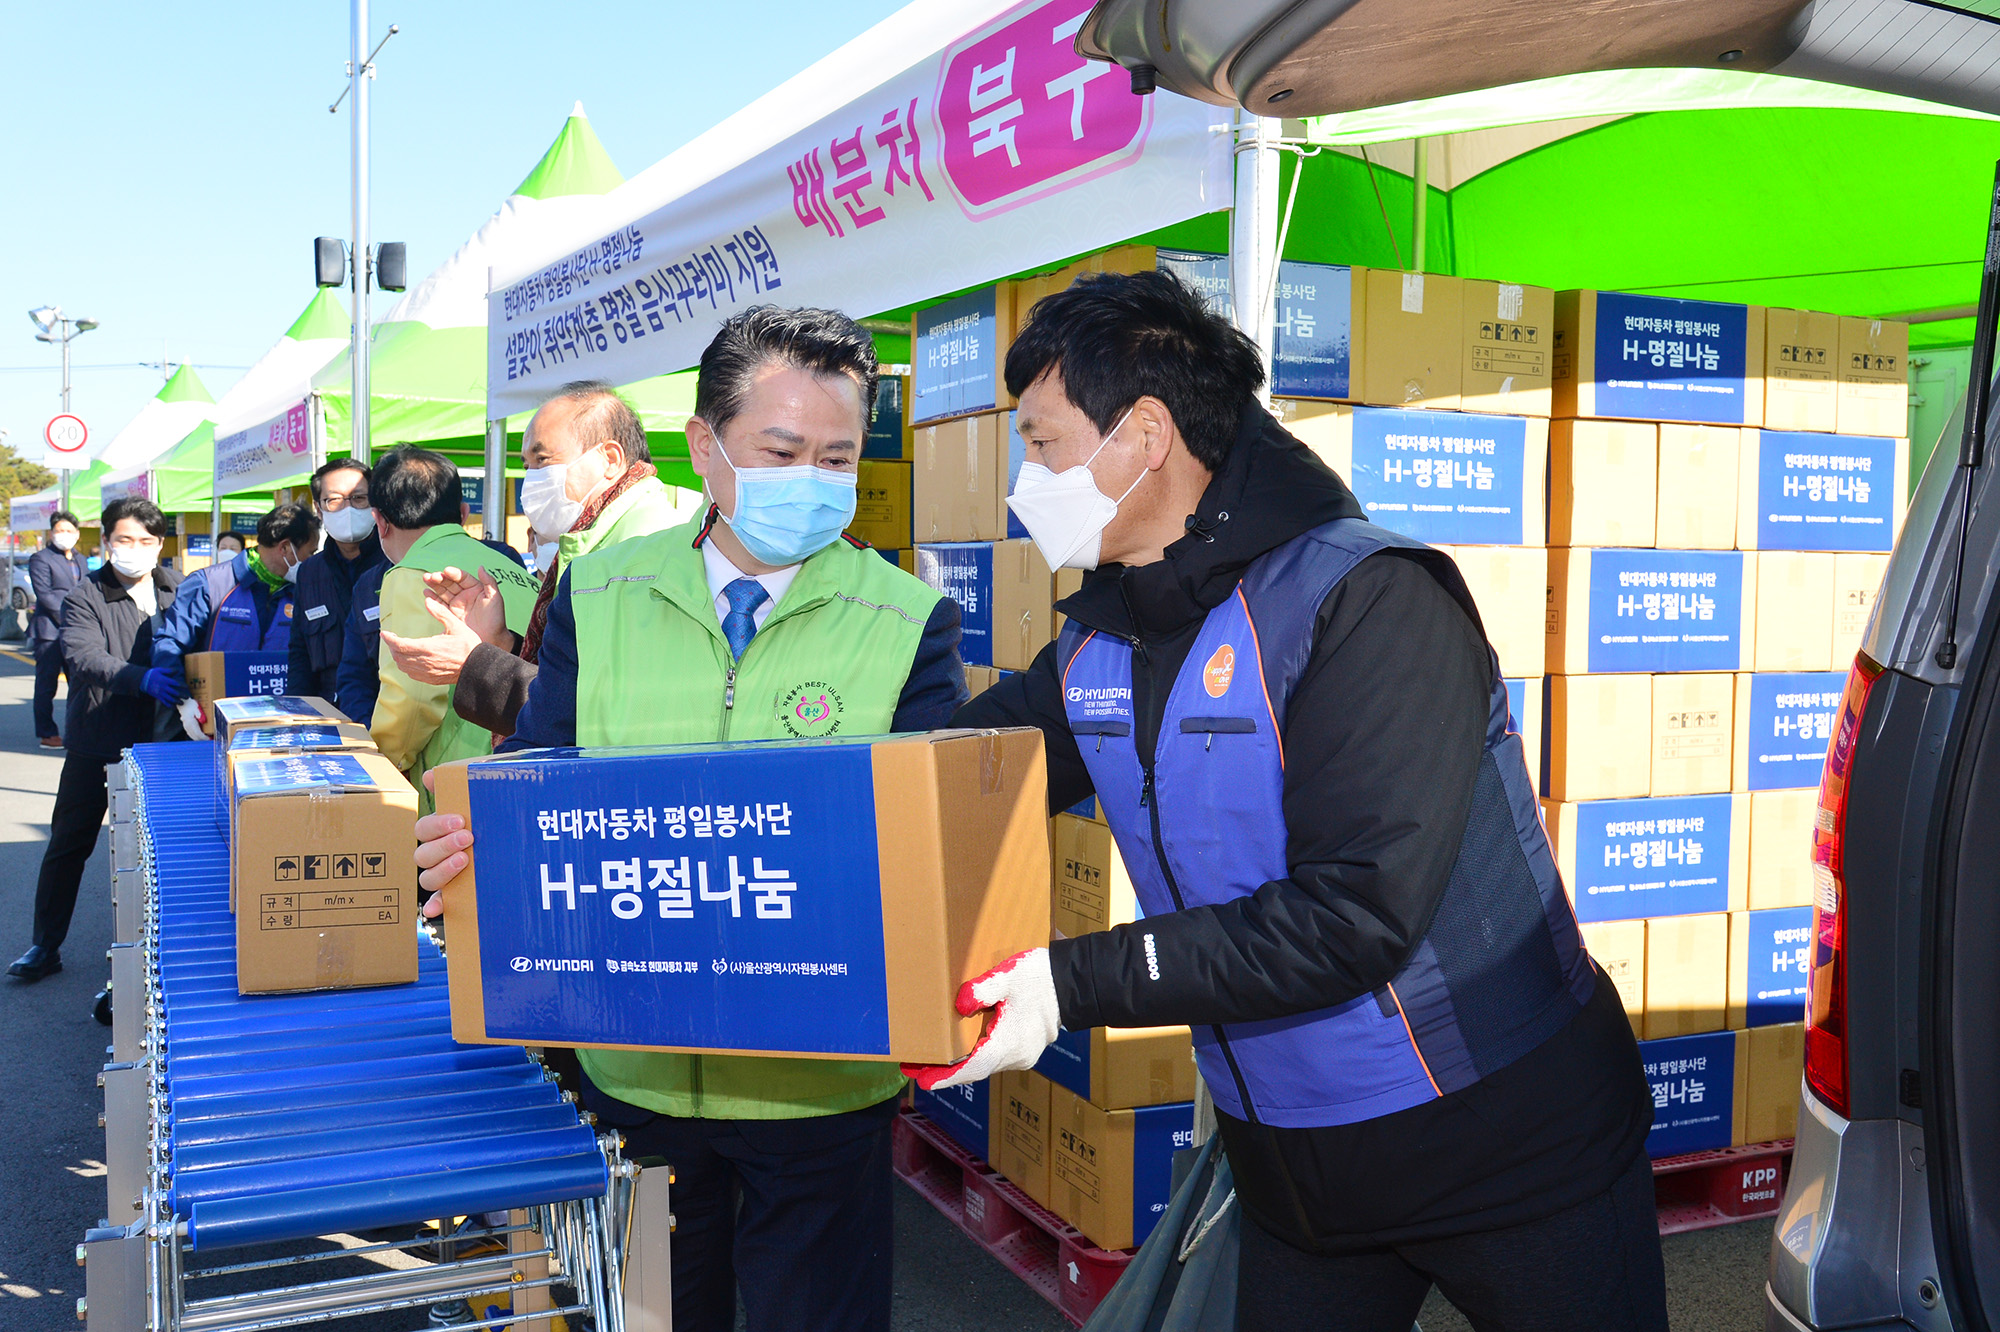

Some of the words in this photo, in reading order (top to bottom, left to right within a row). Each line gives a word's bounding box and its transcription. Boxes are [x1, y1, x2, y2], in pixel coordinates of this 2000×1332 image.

[969, 11, 1111, 168] 북구
[787, 97, 935, 238] 배분처
[504, 285, 545, 322] 현대자동차
[544, 249, 591, 303] 평일봉사단
[590, 225, 645, 278] H-명절나눔
[505, 321, 546, 381] 설맞이
[544, 299, 608, 365] 취약계층
[598, 284, 646, 345] 명절
[635, 243, 737, 333] 음식꾸러미
[723, 225, 782, 295] 지원
[929, 319, 953, 340] 현대자동차
[953, 311, 980, 332] 평일봉사단
[1624, 315, 1673, 334] 현대자동차
[1674, 319, 1721, 338] 평일봉사단
[928, 335, 980, 369] H-명절나눔
[1623, 339, 1720, 371] H-명절나눔
[57, 425, 78, 441] 20
[1385, 434, 1441, 452] 현대자동차
[1441, 436, 1496, 455] 평일봉사단
[1384, 458, 1495, 490] H-명절나눔
[1783, 475, 1871, 503] H-명절나눔
[1617, 592, 1716, 621] H-명절나눔
[249, 664, 289, 676] 현대자동차
[249, 678, 288, 696] H-명
[827, 686, 844, 713] ULSAN
[1085, 687, 1131, 700] HYUNDAI
[1774, 711, 1837, 740] H-명절
[537, 807, 656, 841] 현대자동차
[663, 802, 792, 839] 평일봉사단
[1604, 838, 1704, 869] H-명절나눔
[384, 894, 392, 903] m
[539, 855, 797, 919] H-명절나눔
[378, 911, 392, 921] EA
[535, 959, 594, 971] HYUNDAI
[620, 961, 647, 973] 금속노조
[648, 961, 682, 973] 현대자동차
[684, 961, 698, 973] 지부
[730, 962, 847, 976] (사)울산광역시자원봉사센터
[1659, 1057, 1707, 1075] 평일봉사단
[1651, 1078, 1706, 1108] 절나눔
[1743, 1168, 1776, 1189] KPP
